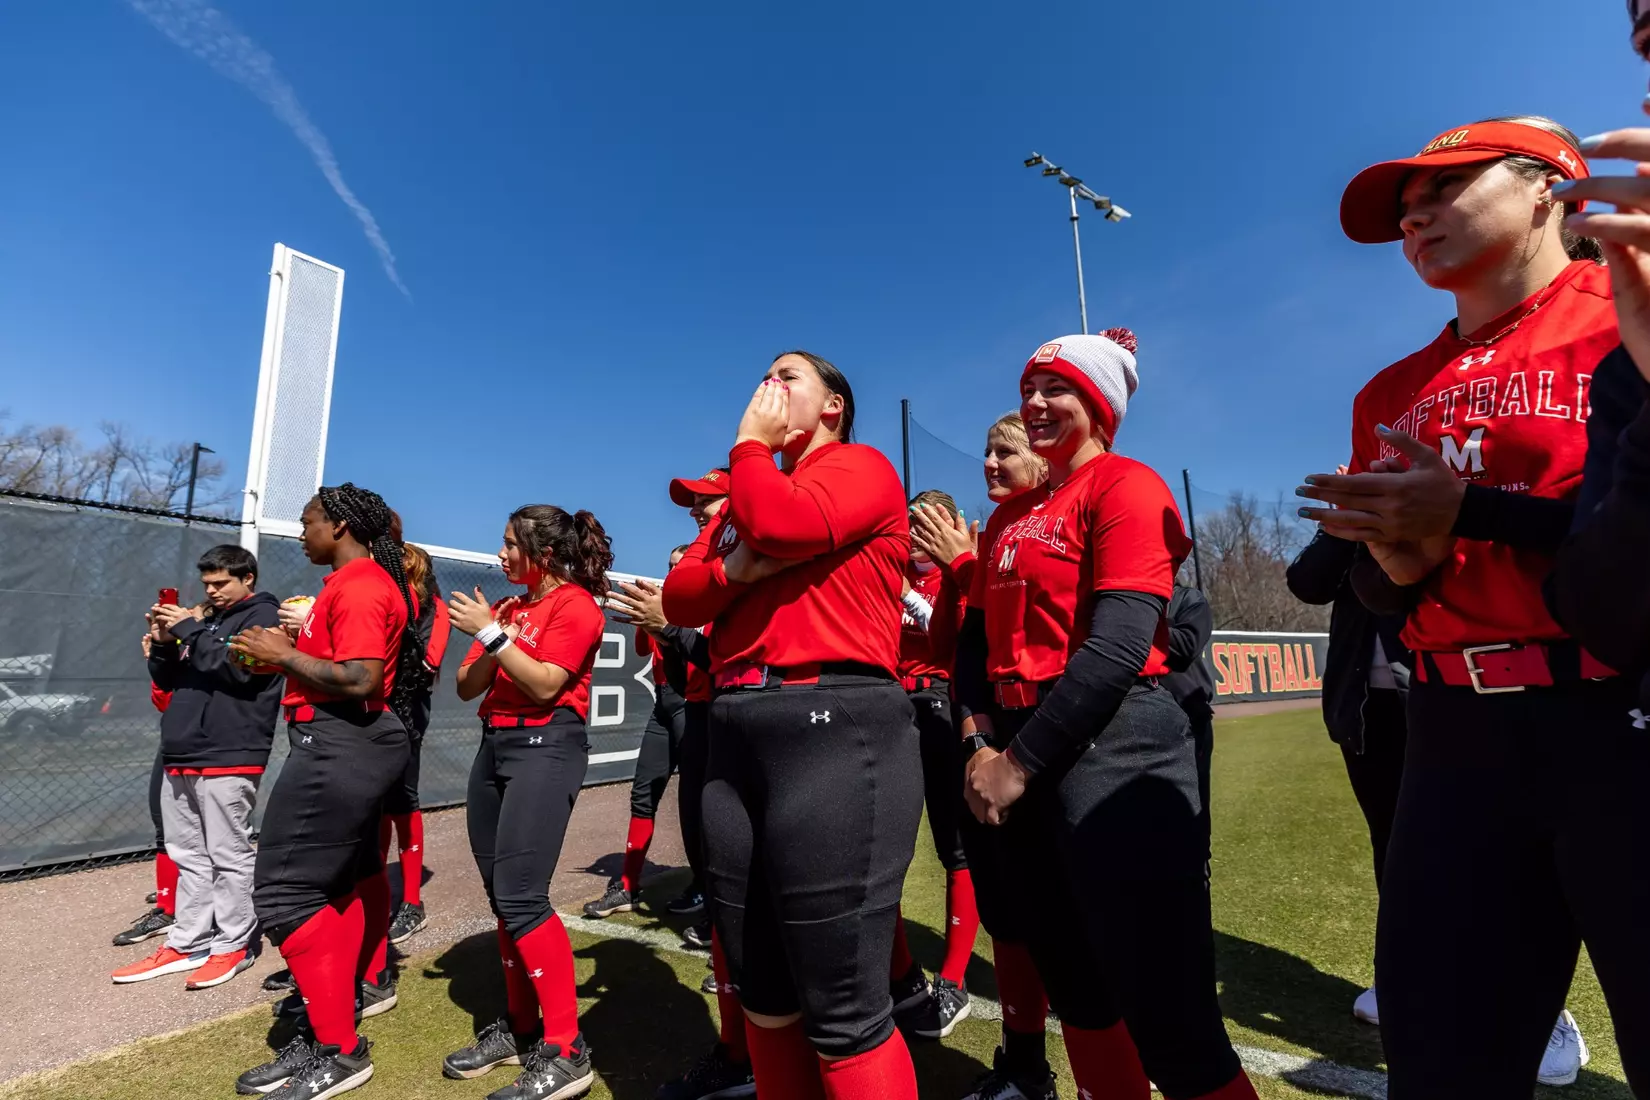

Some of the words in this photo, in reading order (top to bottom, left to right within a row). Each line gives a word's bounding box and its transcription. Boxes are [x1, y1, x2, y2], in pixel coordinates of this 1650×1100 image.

[1440, 427, 1486, 473] M
[718, 523, 738, 548] M
[998, 542, 1019, 573] M
[1211, 642, 1323, 696] SOFTBALL
